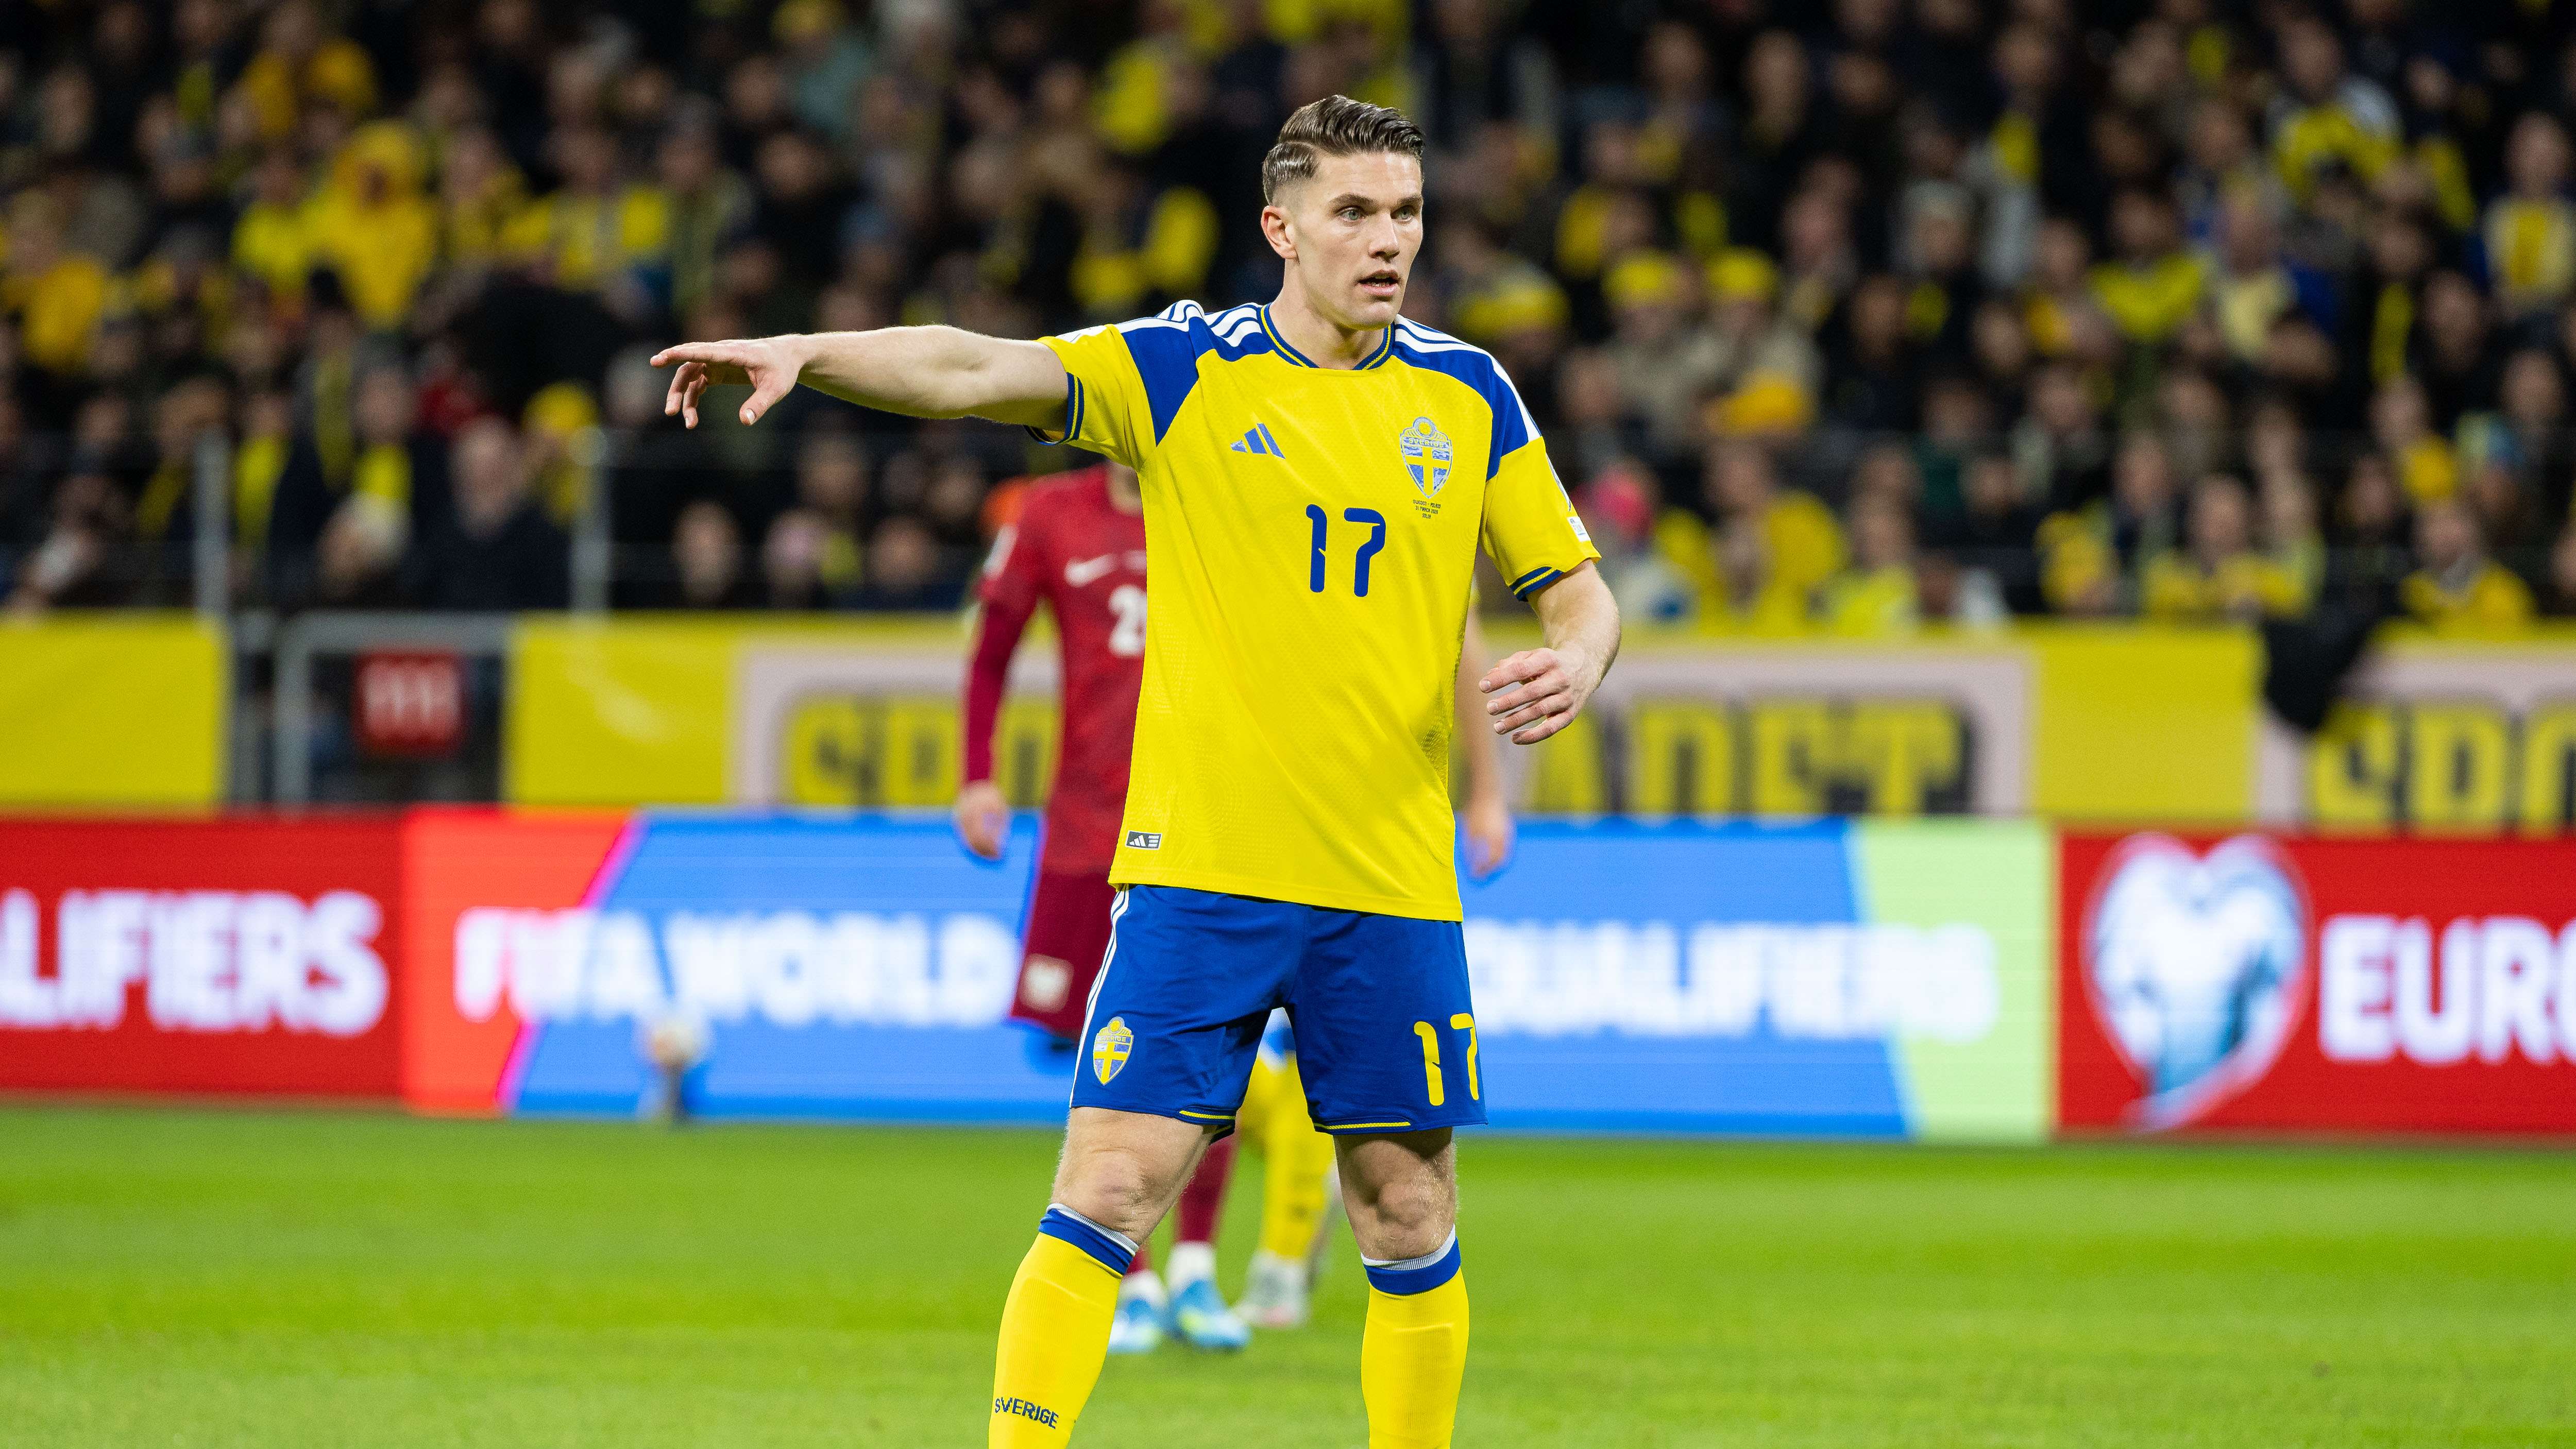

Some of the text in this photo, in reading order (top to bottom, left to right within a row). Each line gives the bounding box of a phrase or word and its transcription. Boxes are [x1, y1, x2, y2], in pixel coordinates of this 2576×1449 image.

[1306, 504, 1386, 598] 17
[662, 909, 1020, 1026] WORLD
[2318, 915, 2576, 1066] EUR
[1413, 1013, 1480, 1106] 17
[995, 1396, 1059, 1429] SVERIGE
